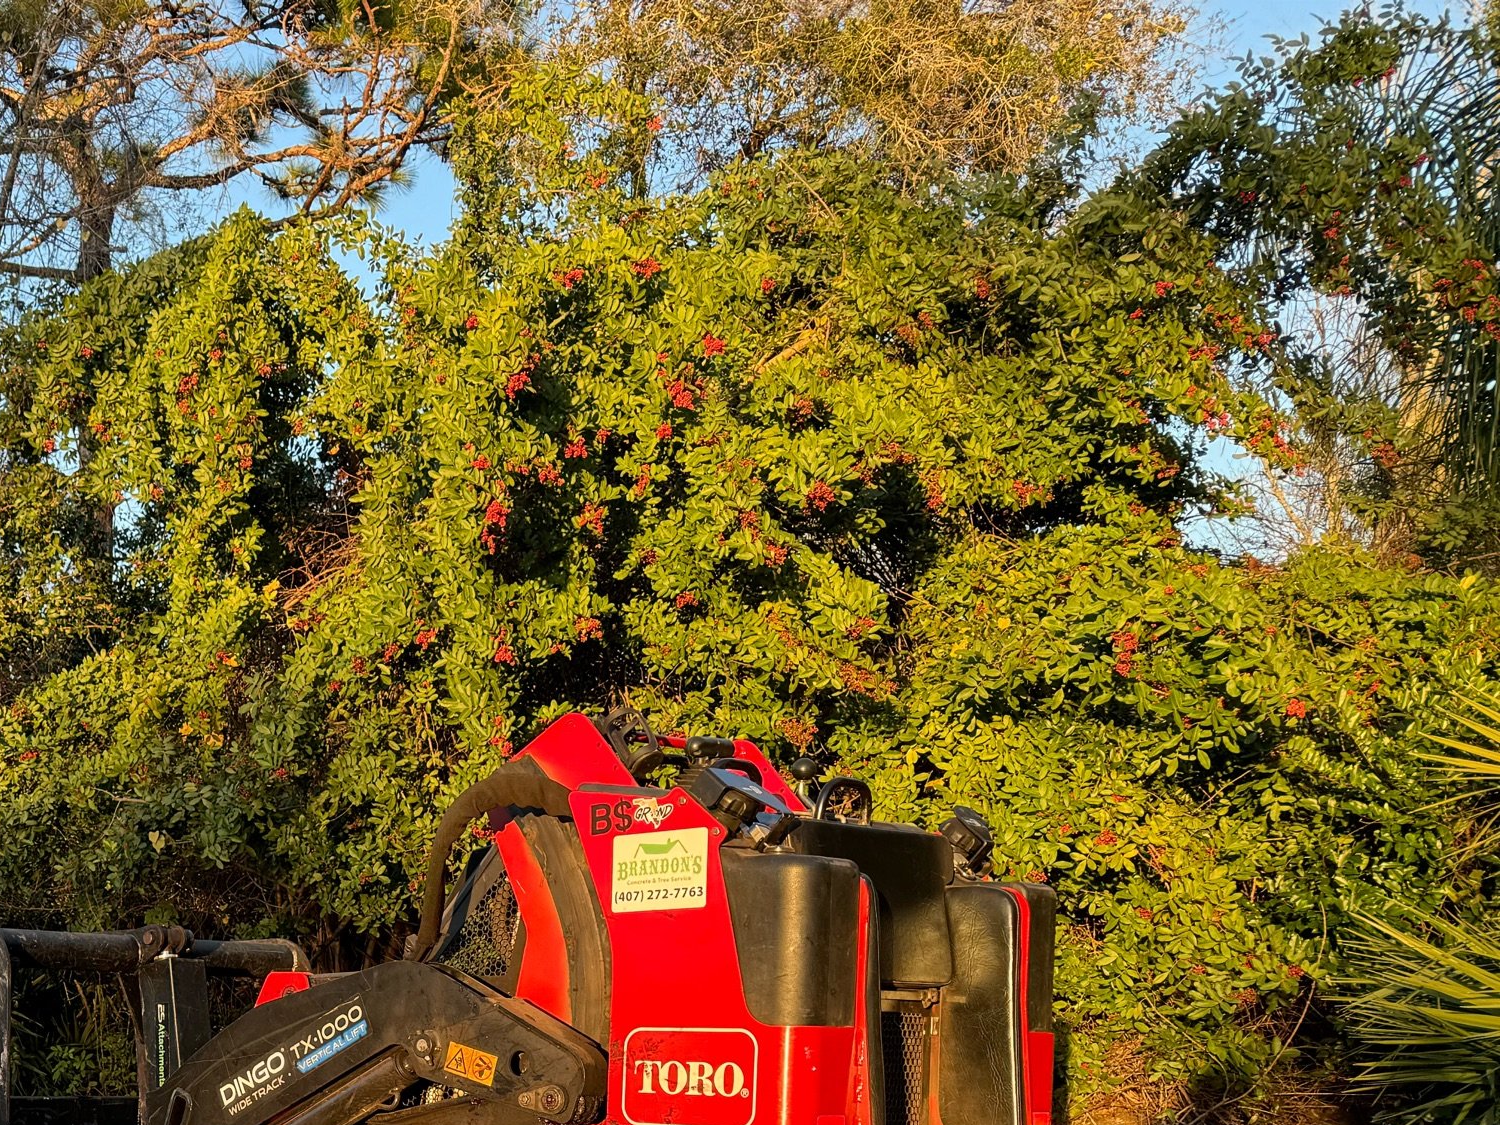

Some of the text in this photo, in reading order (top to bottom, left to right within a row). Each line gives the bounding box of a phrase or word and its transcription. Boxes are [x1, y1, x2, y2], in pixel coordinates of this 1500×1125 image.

[617, 855, 702, 881] BRANDON'S
[614, 886, 704, 904] (407) 272-7763
[228, 1022, 366, 1116] WIDE TRACK VERTICAL LIFT
